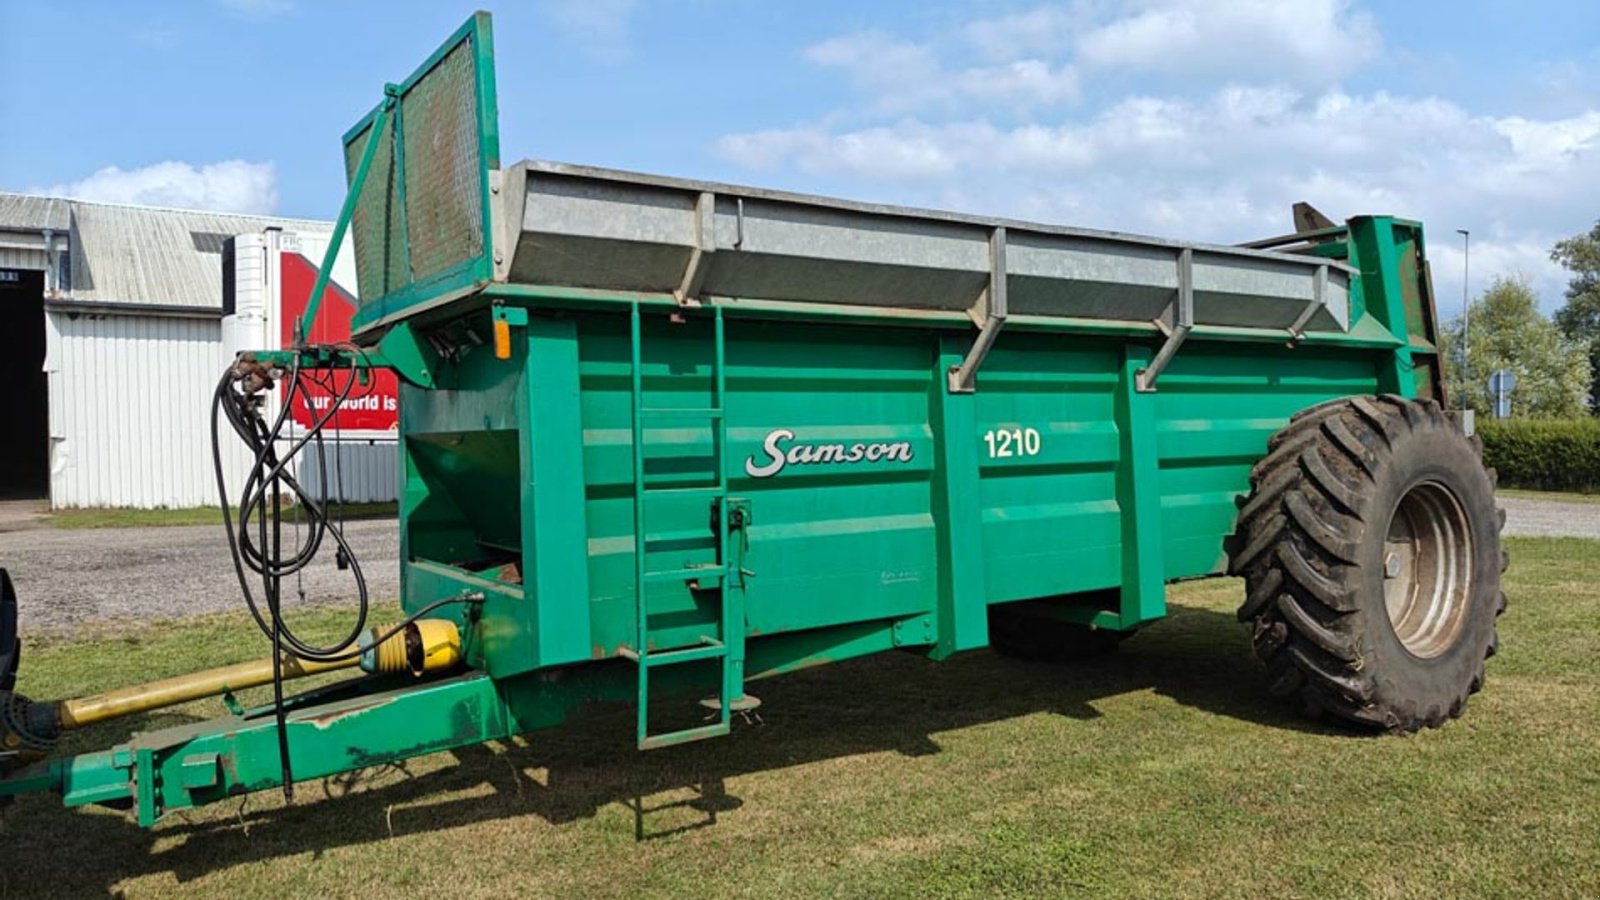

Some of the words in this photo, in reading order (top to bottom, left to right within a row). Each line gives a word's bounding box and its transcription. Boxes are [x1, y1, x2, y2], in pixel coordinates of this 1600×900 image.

[384, 395, 397, 411] is
[745, 429, 913, 477] Samson
[984, 428, 1040, 458] 1210
